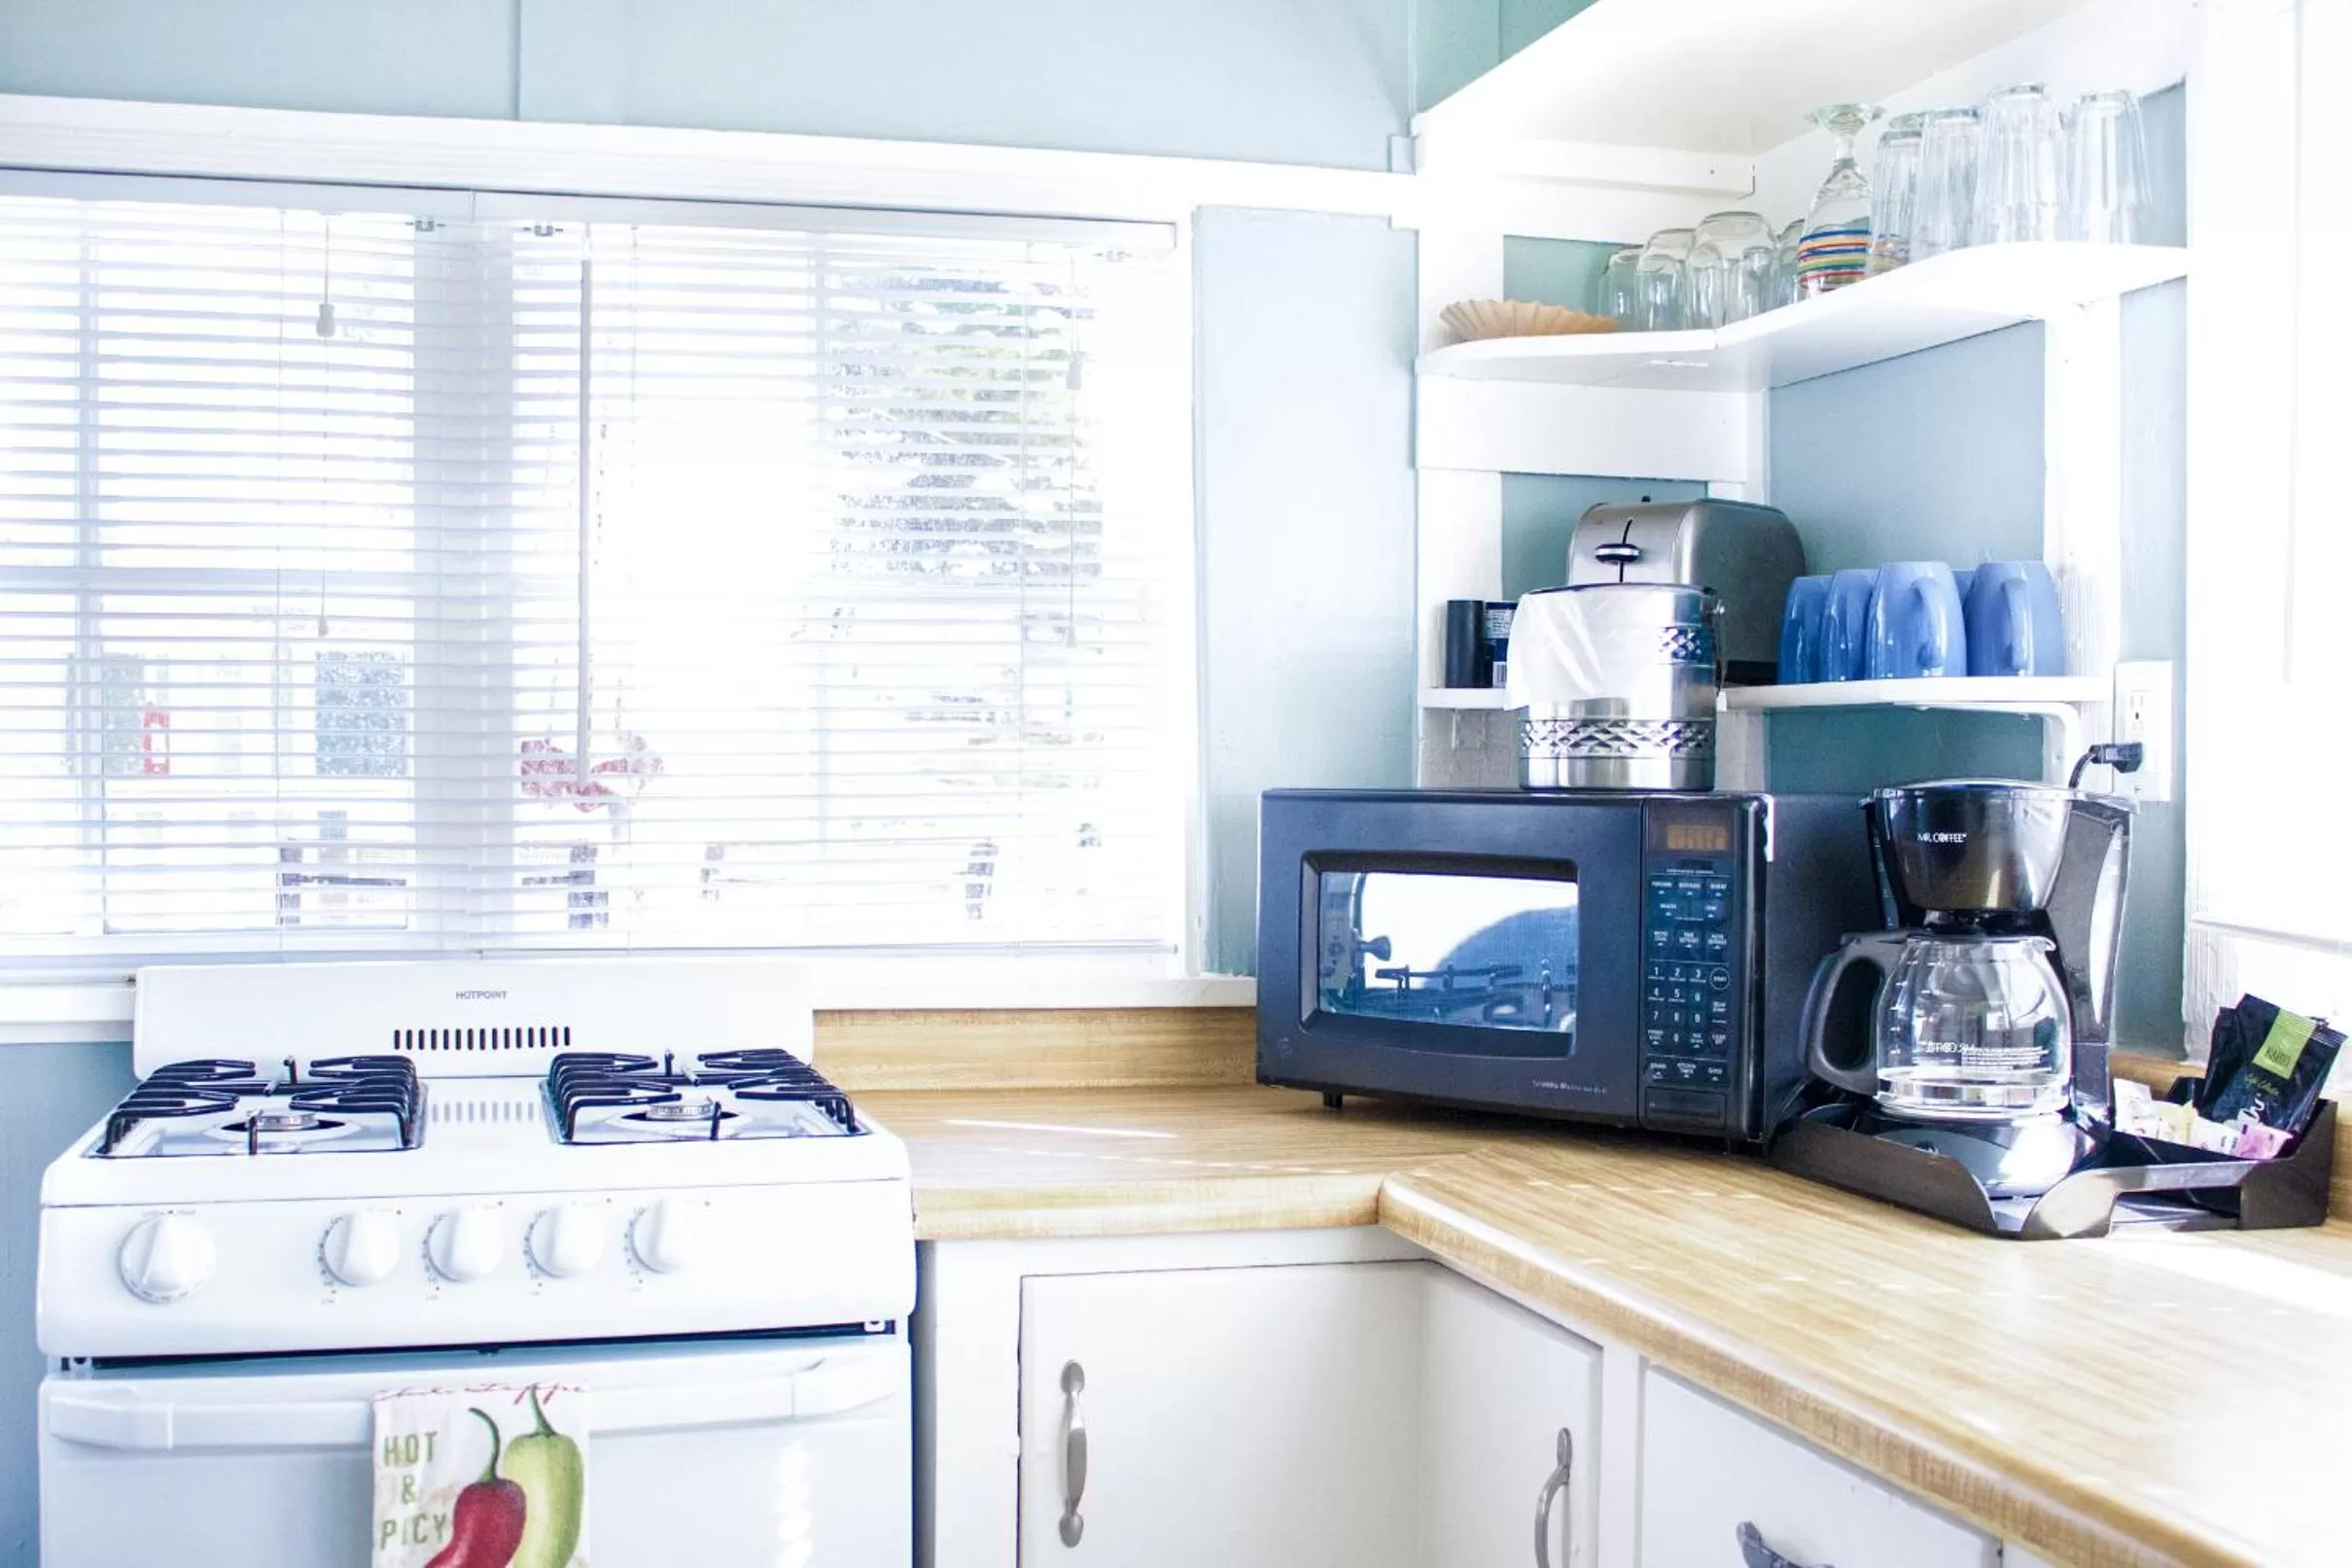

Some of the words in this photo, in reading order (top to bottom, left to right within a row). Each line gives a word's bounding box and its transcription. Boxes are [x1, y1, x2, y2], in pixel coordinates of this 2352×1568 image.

[455, 990, 507, 999] HOTPOINT
[383, 1431, 438, 1467] HOT
[402, 1474, 416, 1505] &
